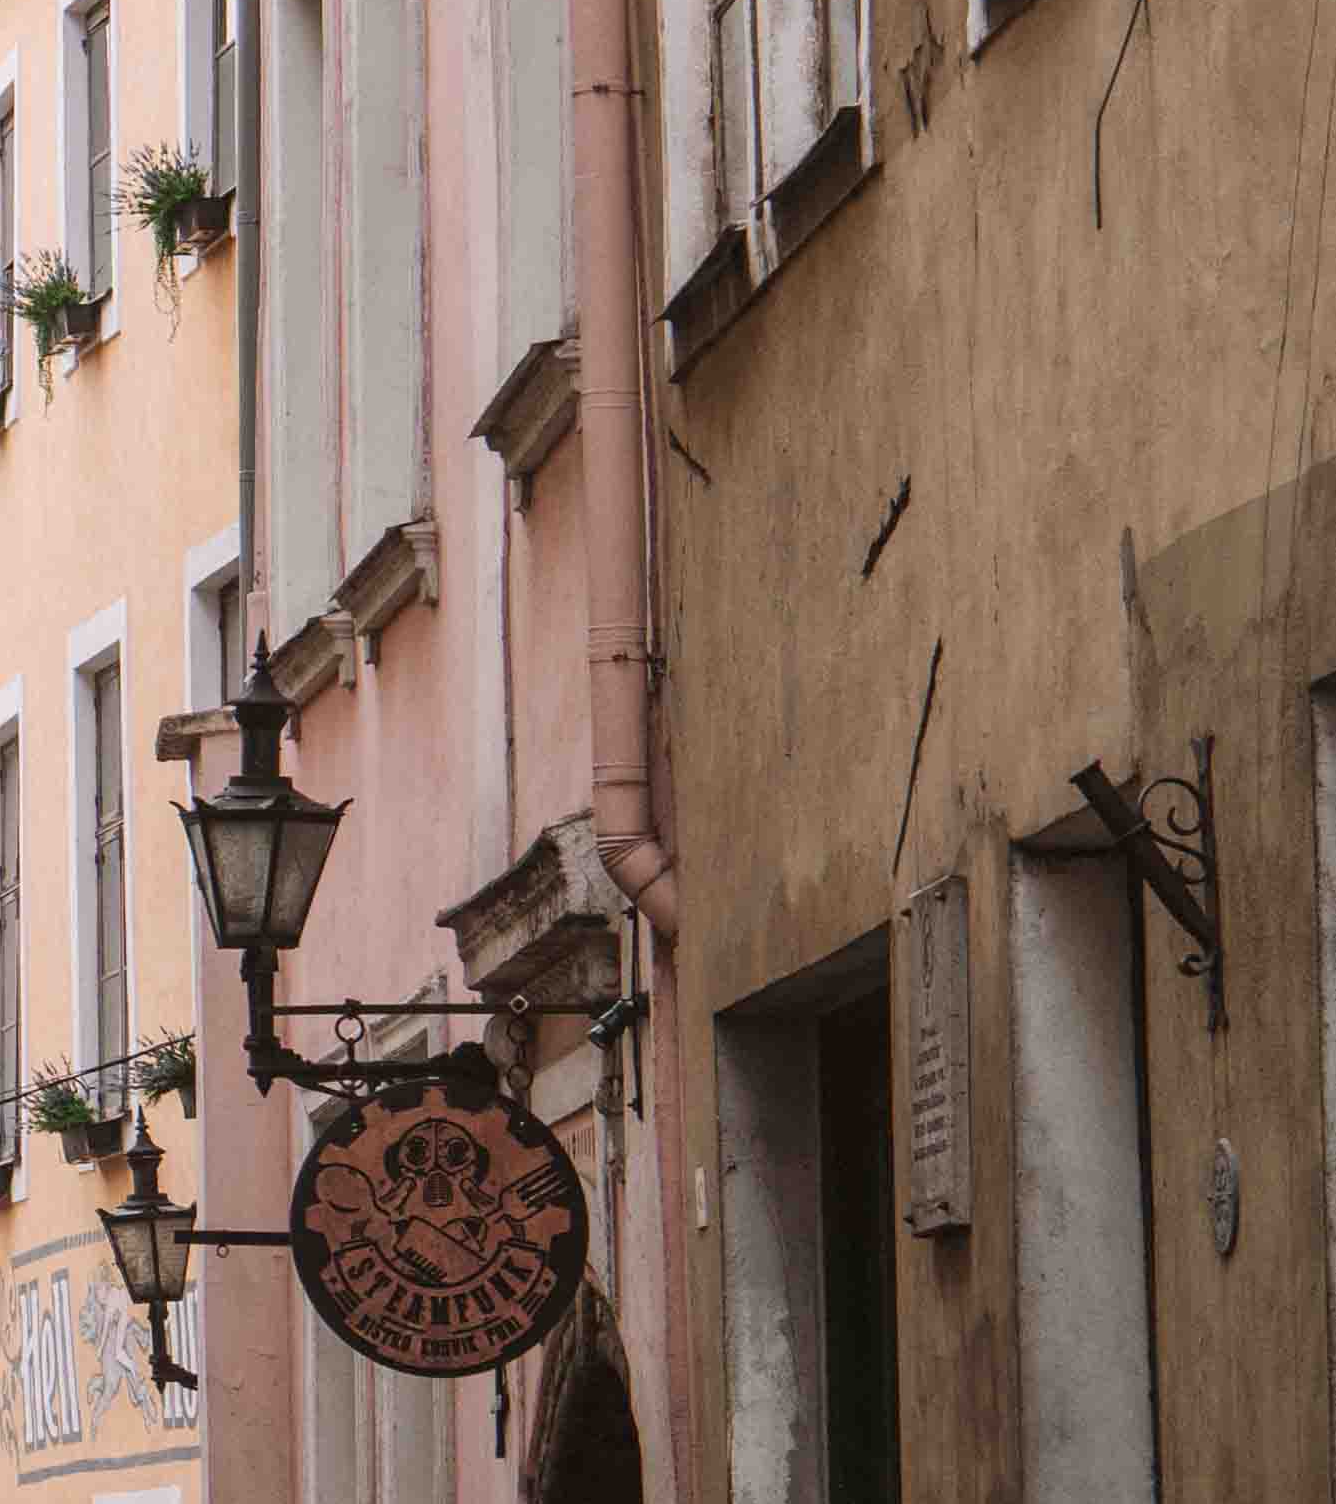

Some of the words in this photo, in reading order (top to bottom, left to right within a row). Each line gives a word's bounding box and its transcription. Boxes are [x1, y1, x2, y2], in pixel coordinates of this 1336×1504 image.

[347, 1255, 534, 1325] STEAMPUNK
[17, 1267, 82, 1454] Hell
[358, 1314, 413, 1351] BISTRO
